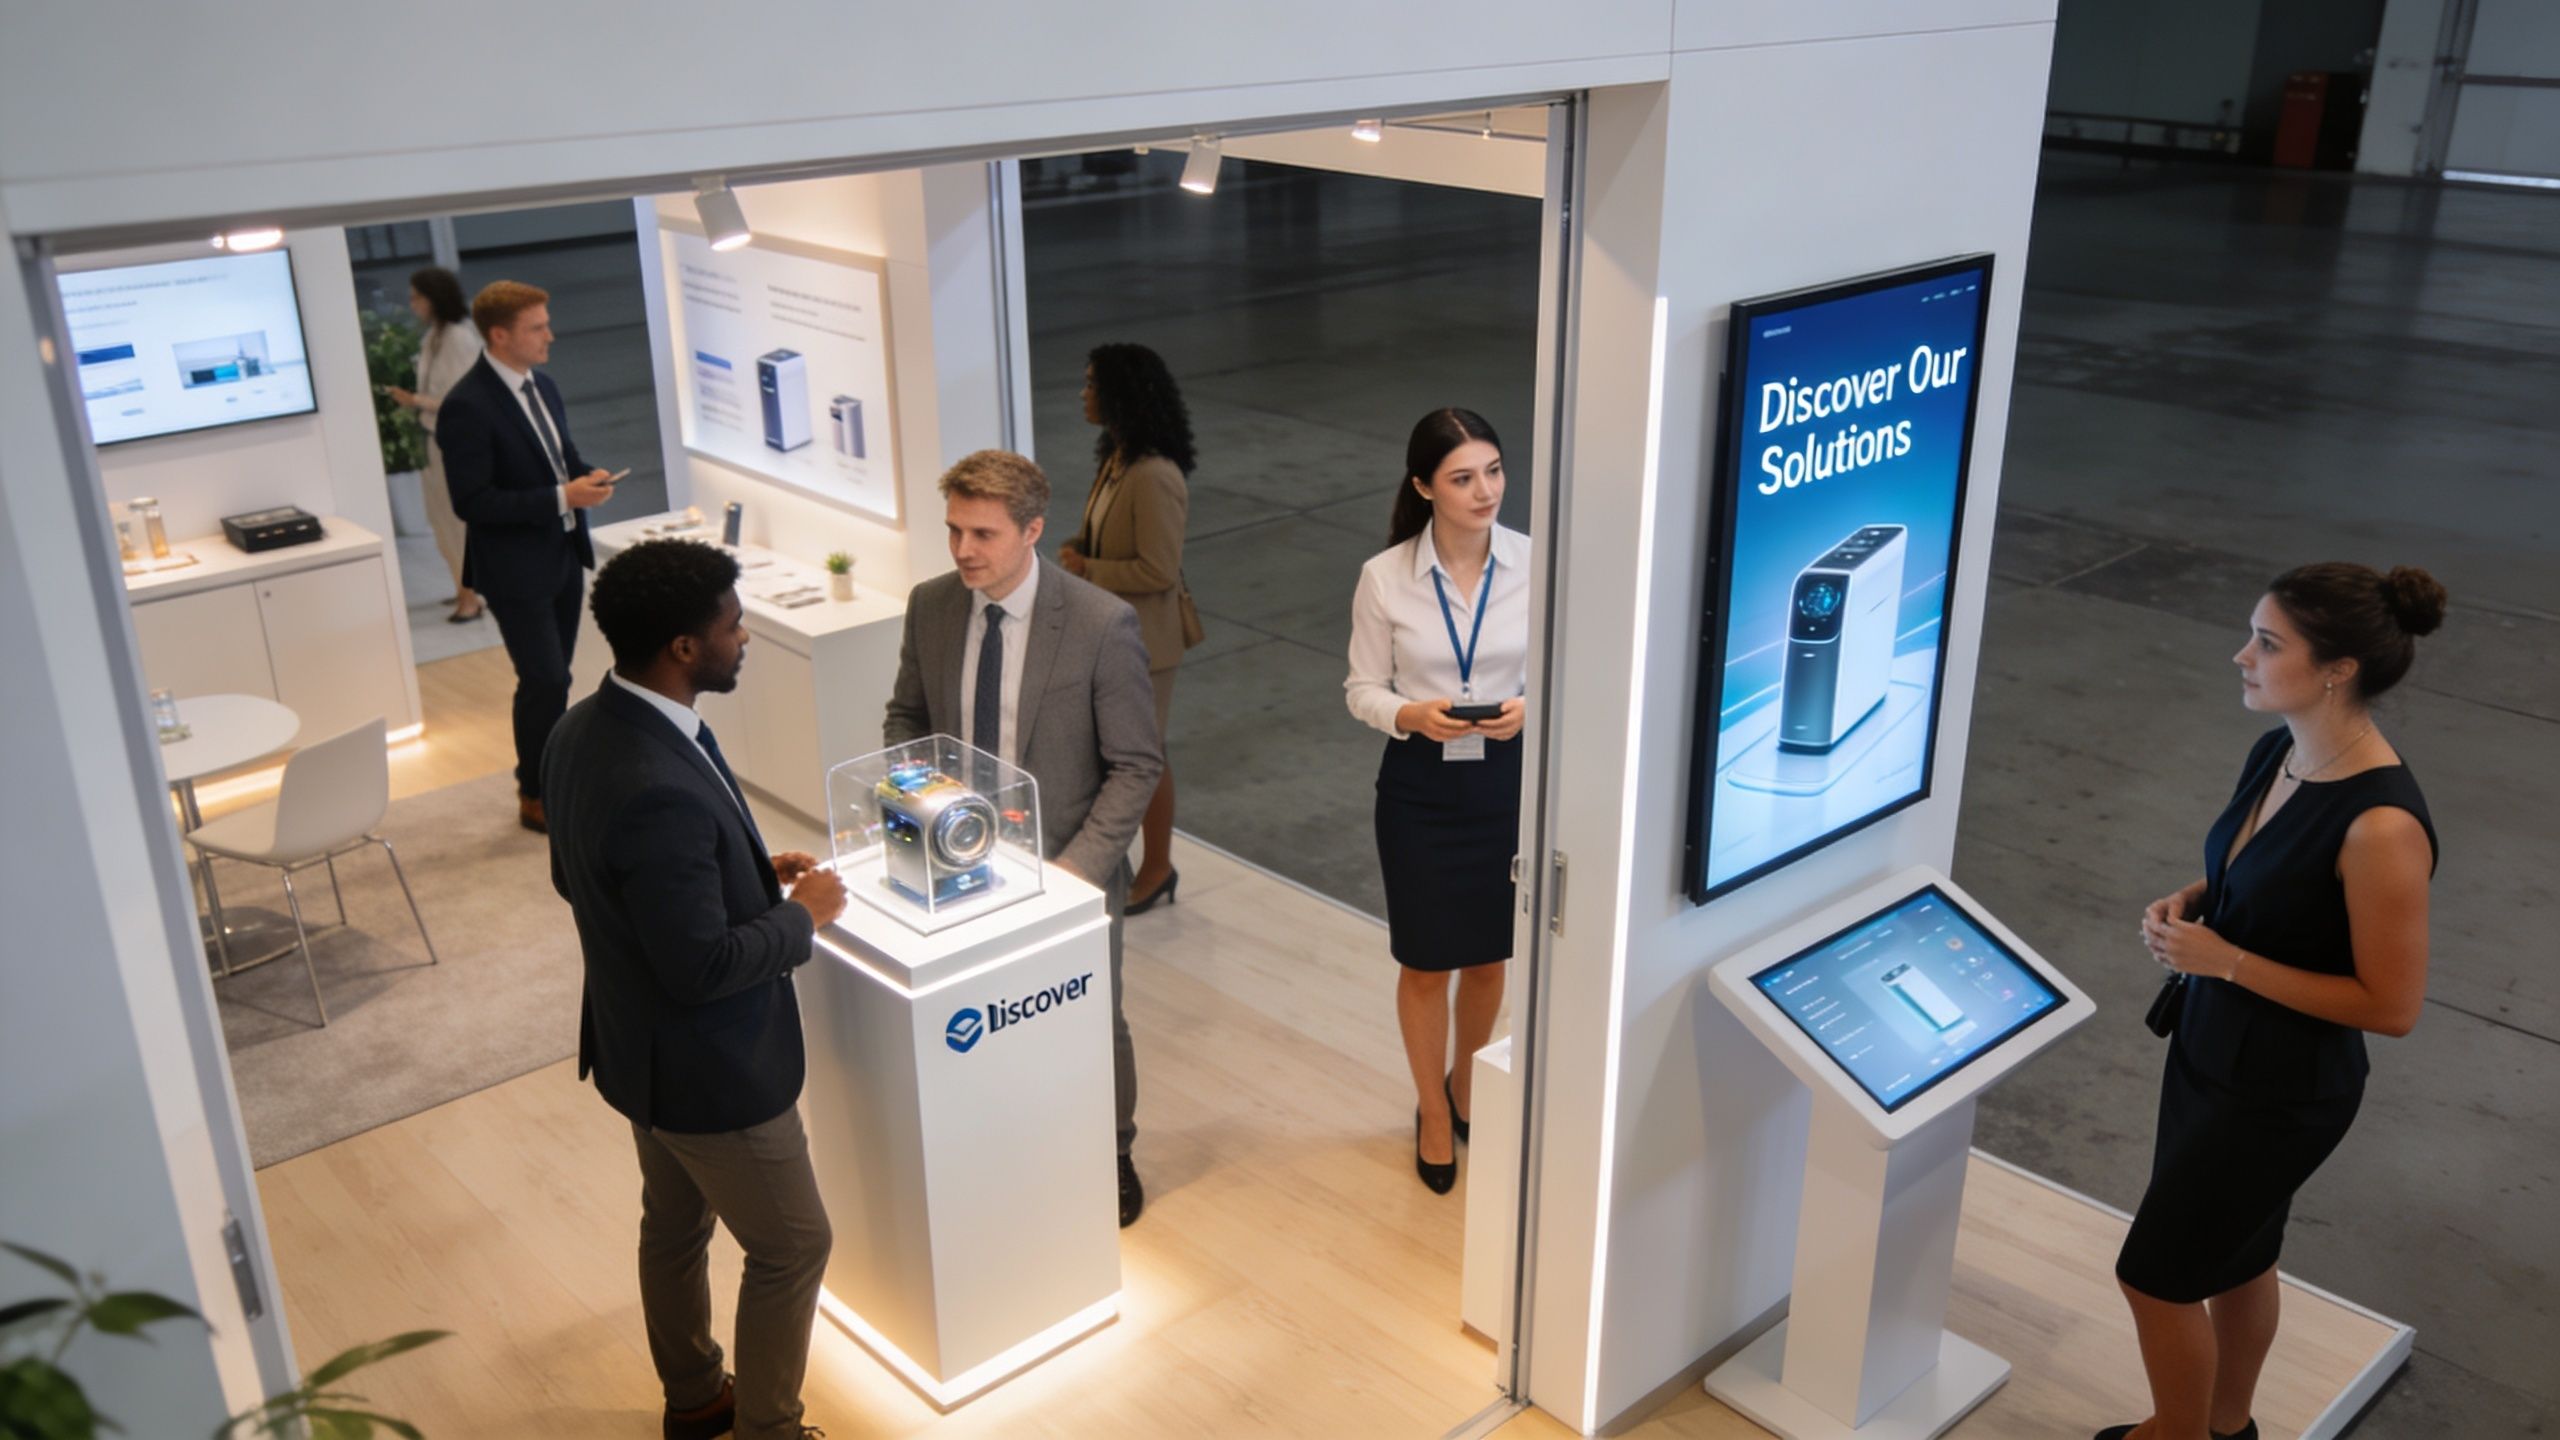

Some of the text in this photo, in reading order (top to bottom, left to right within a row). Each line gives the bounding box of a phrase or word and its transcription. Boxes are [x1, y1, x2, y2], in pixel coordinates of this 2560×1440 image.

[1759, 345, 1967, 433] Discover Our
[1758, 420, 1912, 495] Solutions
